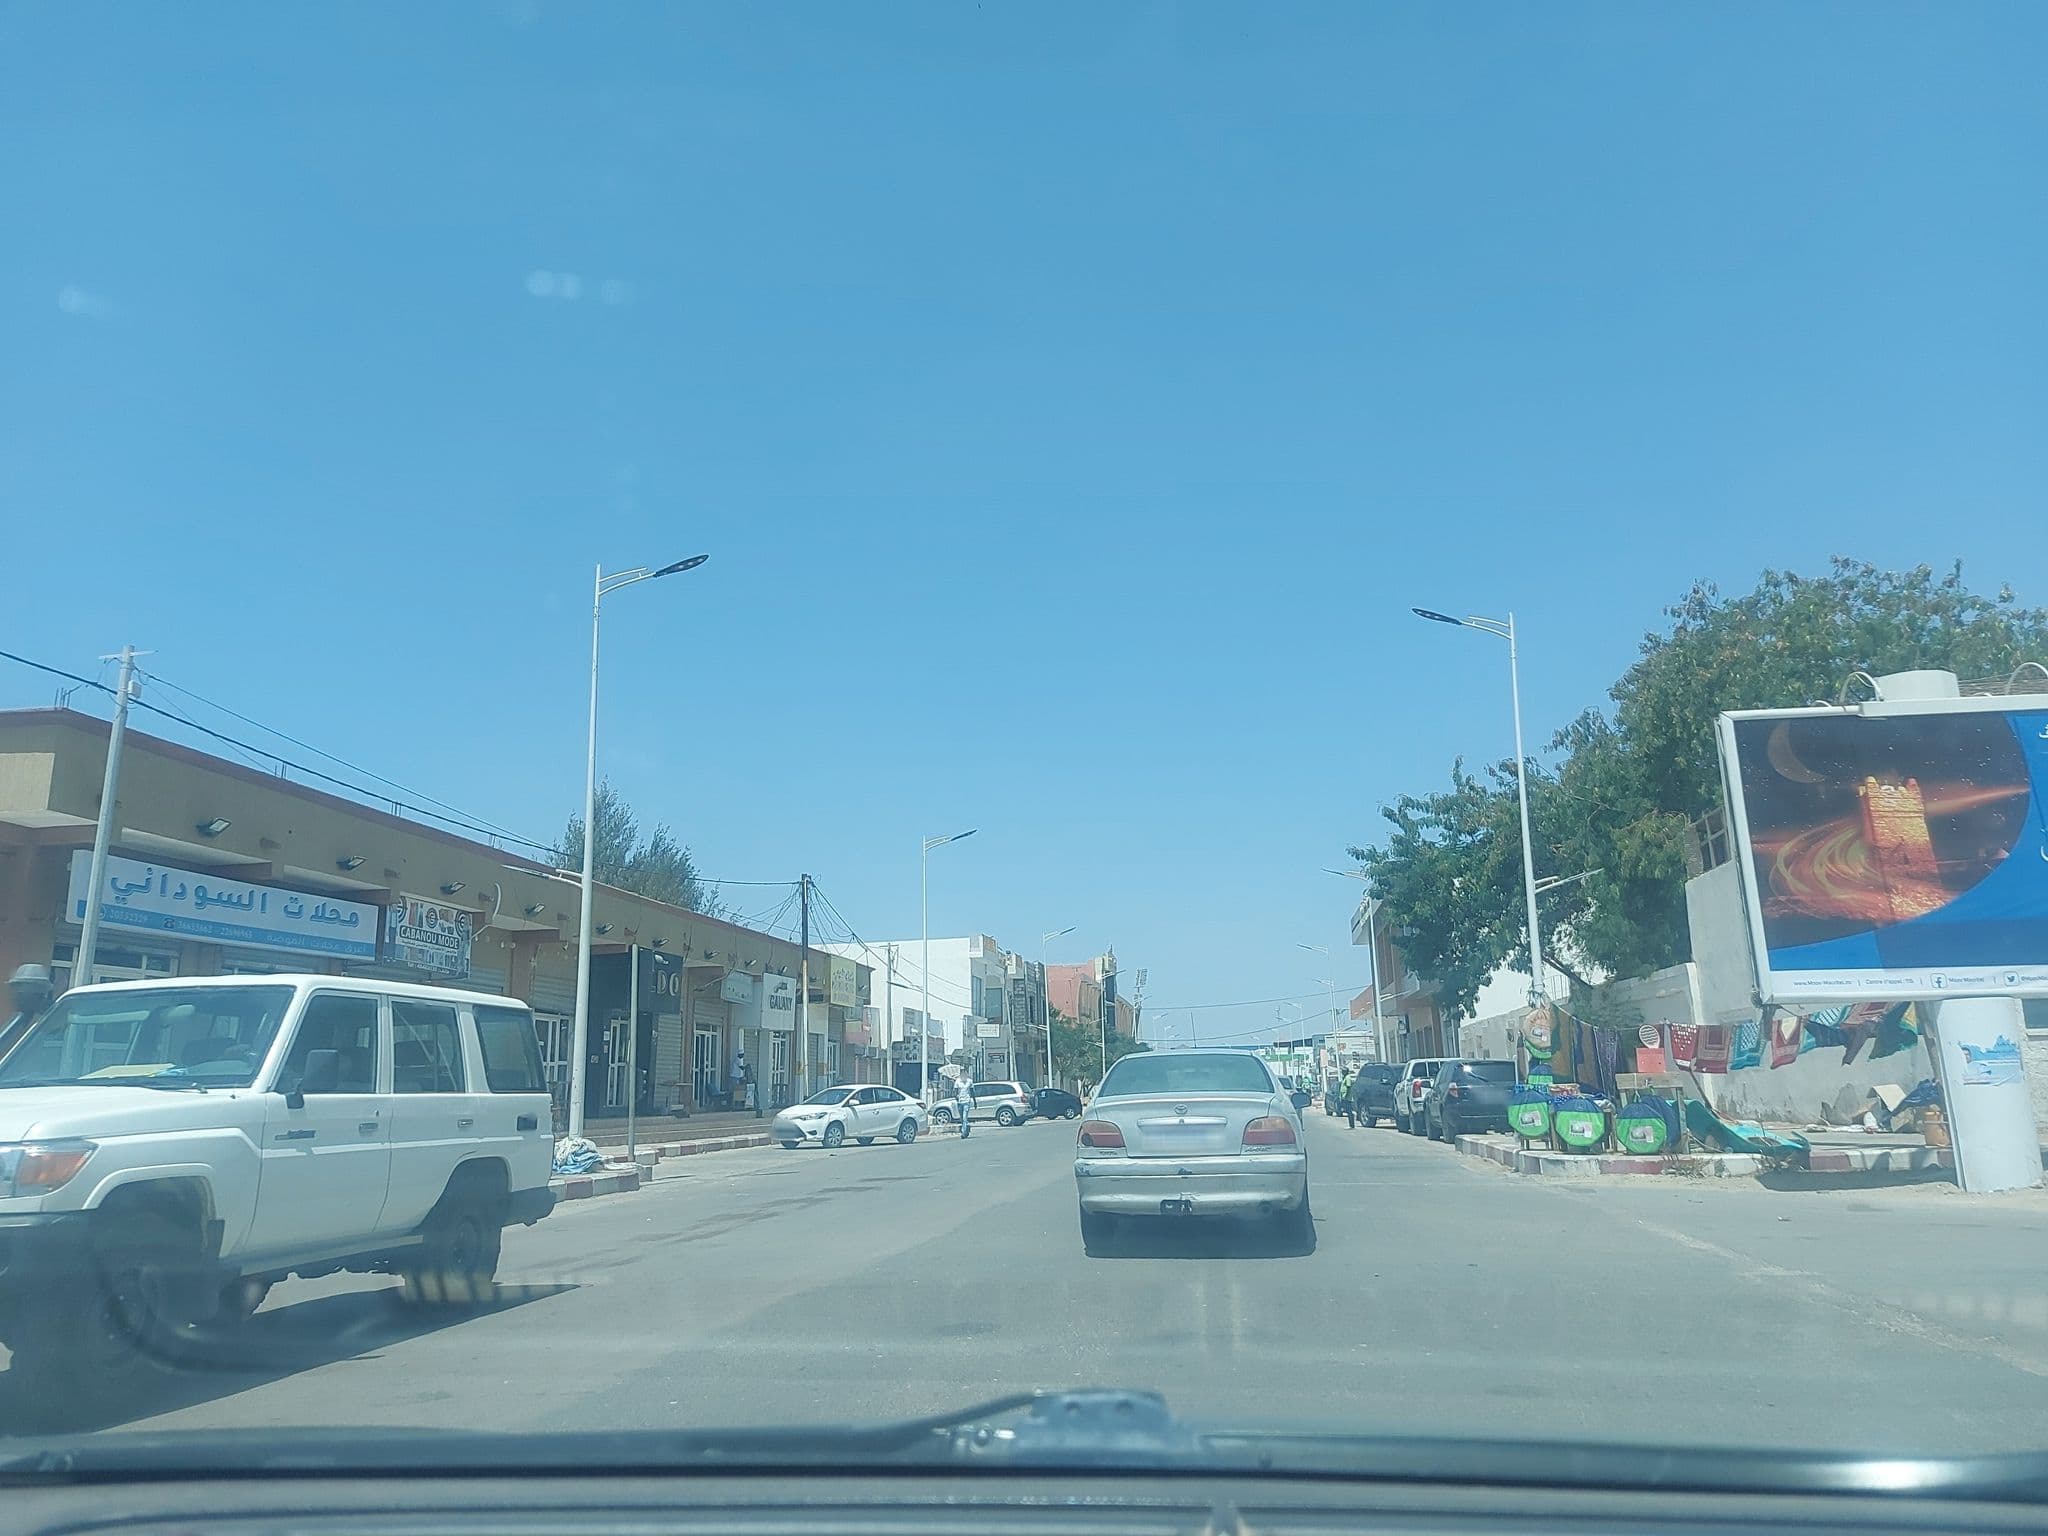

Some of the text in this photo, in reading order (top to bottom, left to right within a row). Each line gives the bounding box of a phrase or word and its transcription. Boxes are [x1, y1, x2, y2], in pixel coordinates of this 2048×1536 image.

[110, 867, 360, 928] محلات السوداني
[401, 926, 437, 944] CABANOU
[438, 934, 459, 950] MODE
